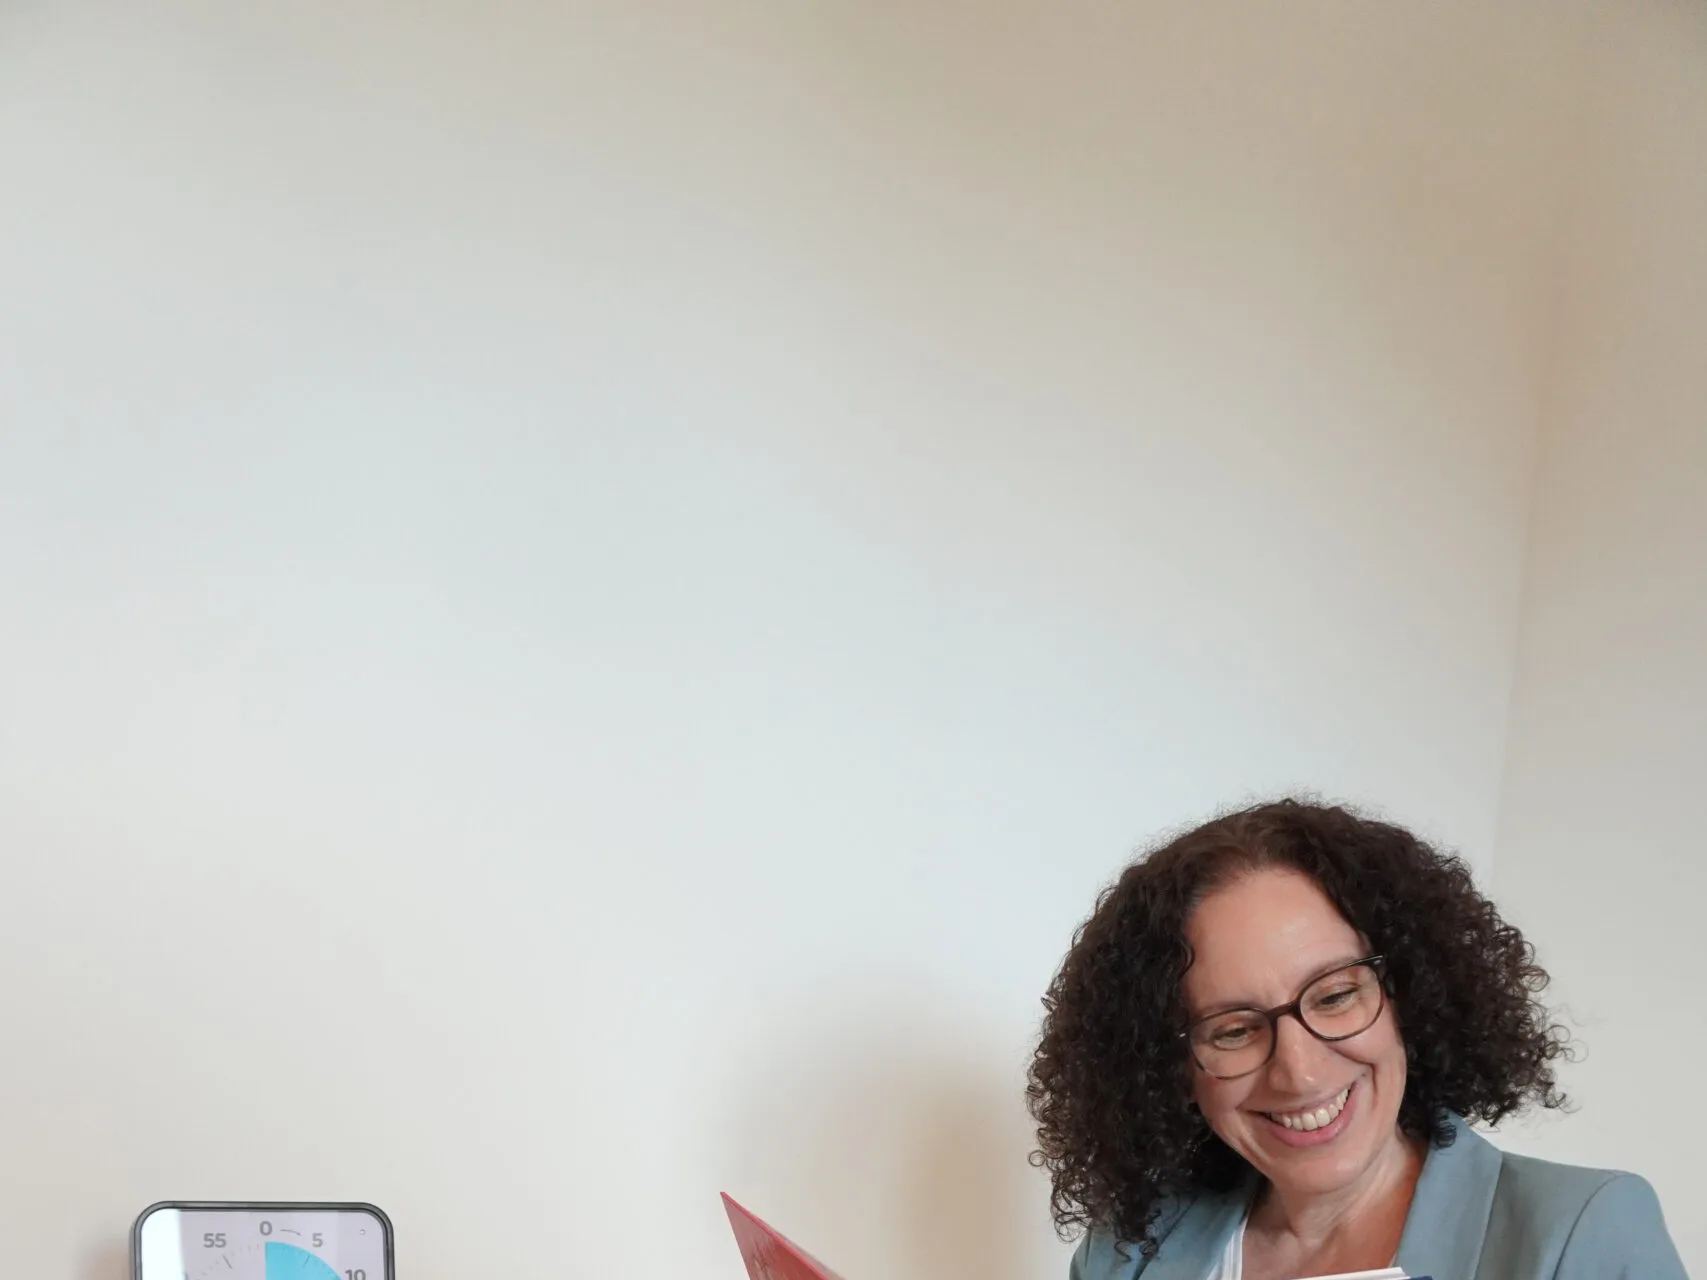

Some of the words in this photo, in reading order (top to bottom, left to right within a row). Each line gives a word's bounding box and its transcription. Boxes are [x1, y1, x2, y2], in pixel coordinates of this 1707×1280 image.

[259, 1221, 273, 1236] 0
[203, 1233, 227, 1248] 55
[312, 1233, 323, 1248] 5
